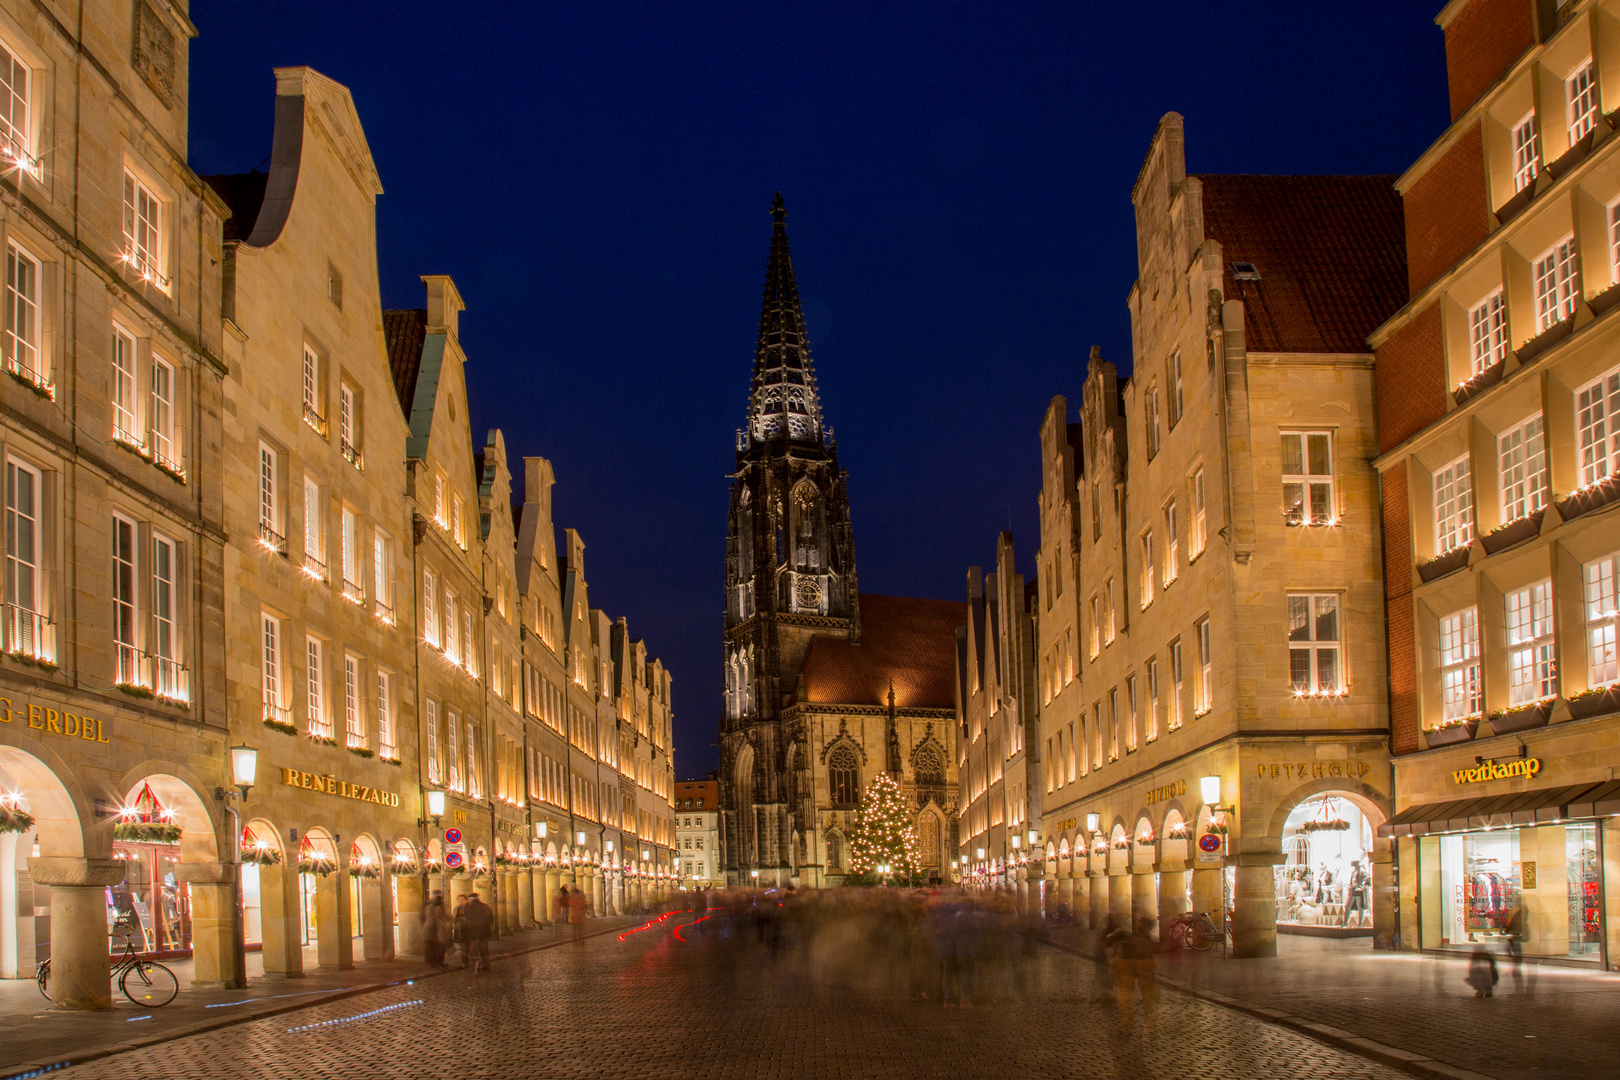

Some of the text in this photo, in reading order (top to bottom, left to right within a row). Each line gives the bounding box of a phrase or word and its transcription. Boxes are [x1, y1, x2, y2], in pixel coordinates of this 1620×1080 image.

[1258, 763, 1371, 779] PETZHOLD
[1452, 757, 1540, 784] weitkamp
[283, 767, 400, 808] RENÉ LEZARD
[1146, 779, 1187, 806] PETZHOLD
